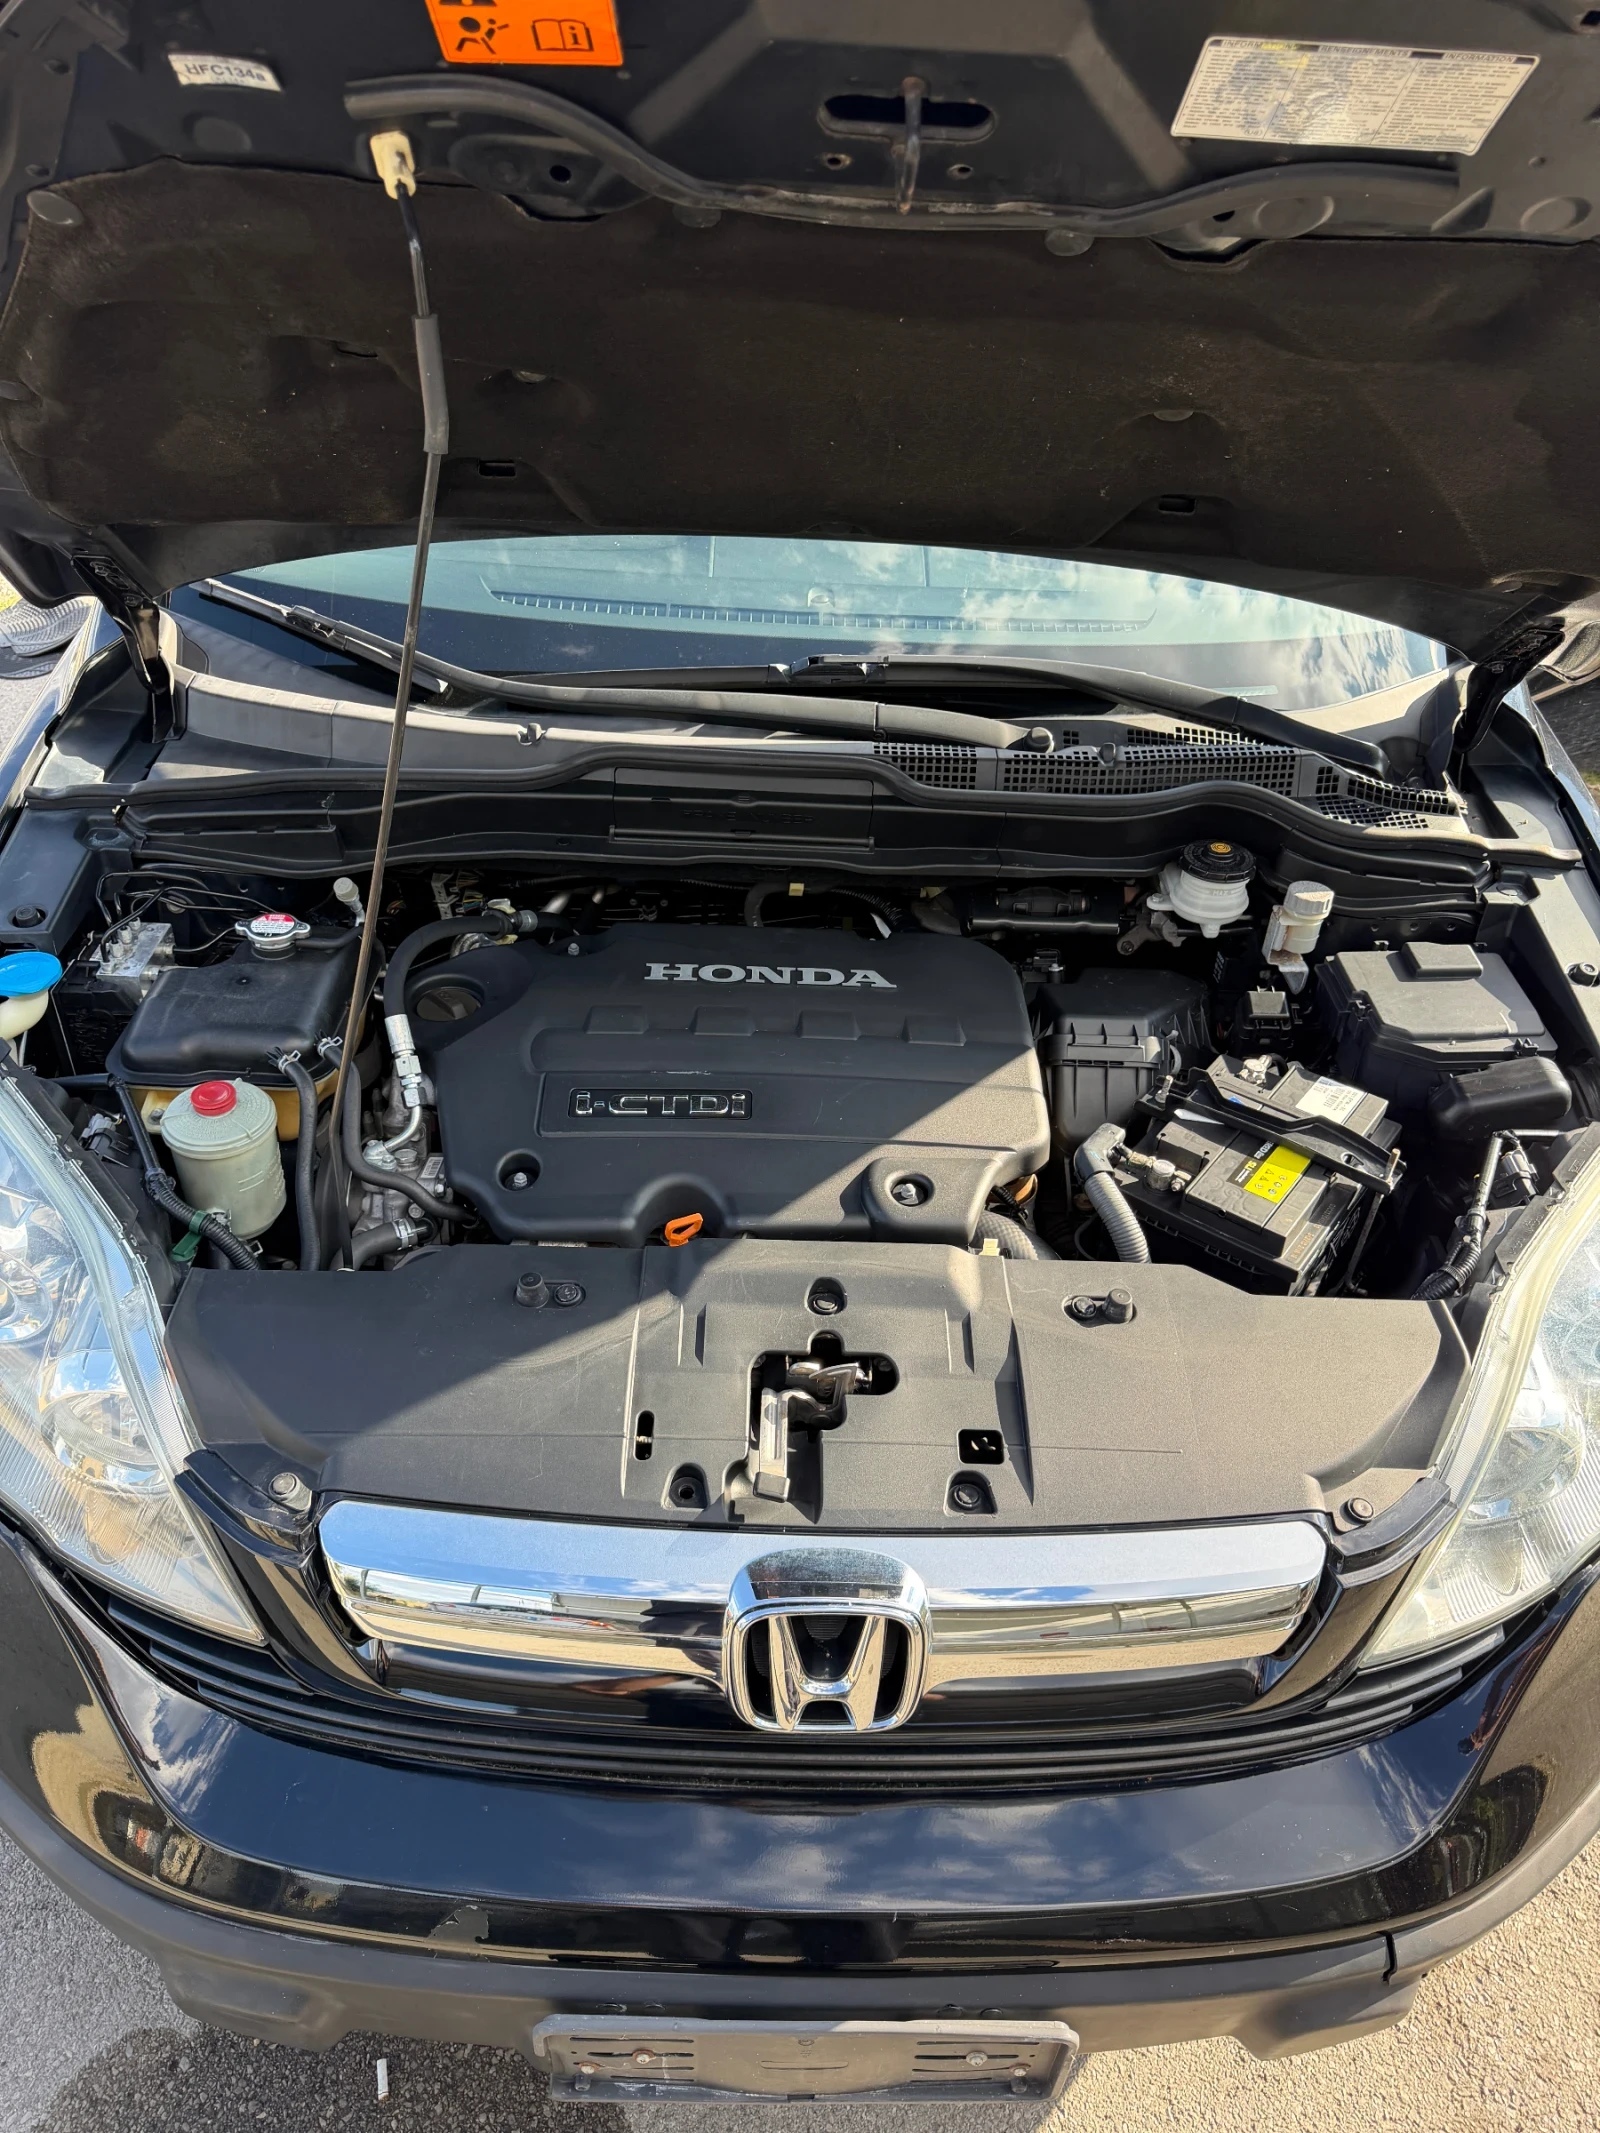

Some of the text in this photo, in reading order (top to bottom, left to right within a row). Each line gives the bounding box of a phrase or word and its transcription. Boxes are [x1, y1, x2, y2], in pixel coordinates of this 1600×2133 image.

[1445, 52, 1515, 63] INFORMATION
[644, 962, 897, 989] HONDA
[574, 1091, 747, 1117] i-CTDi
